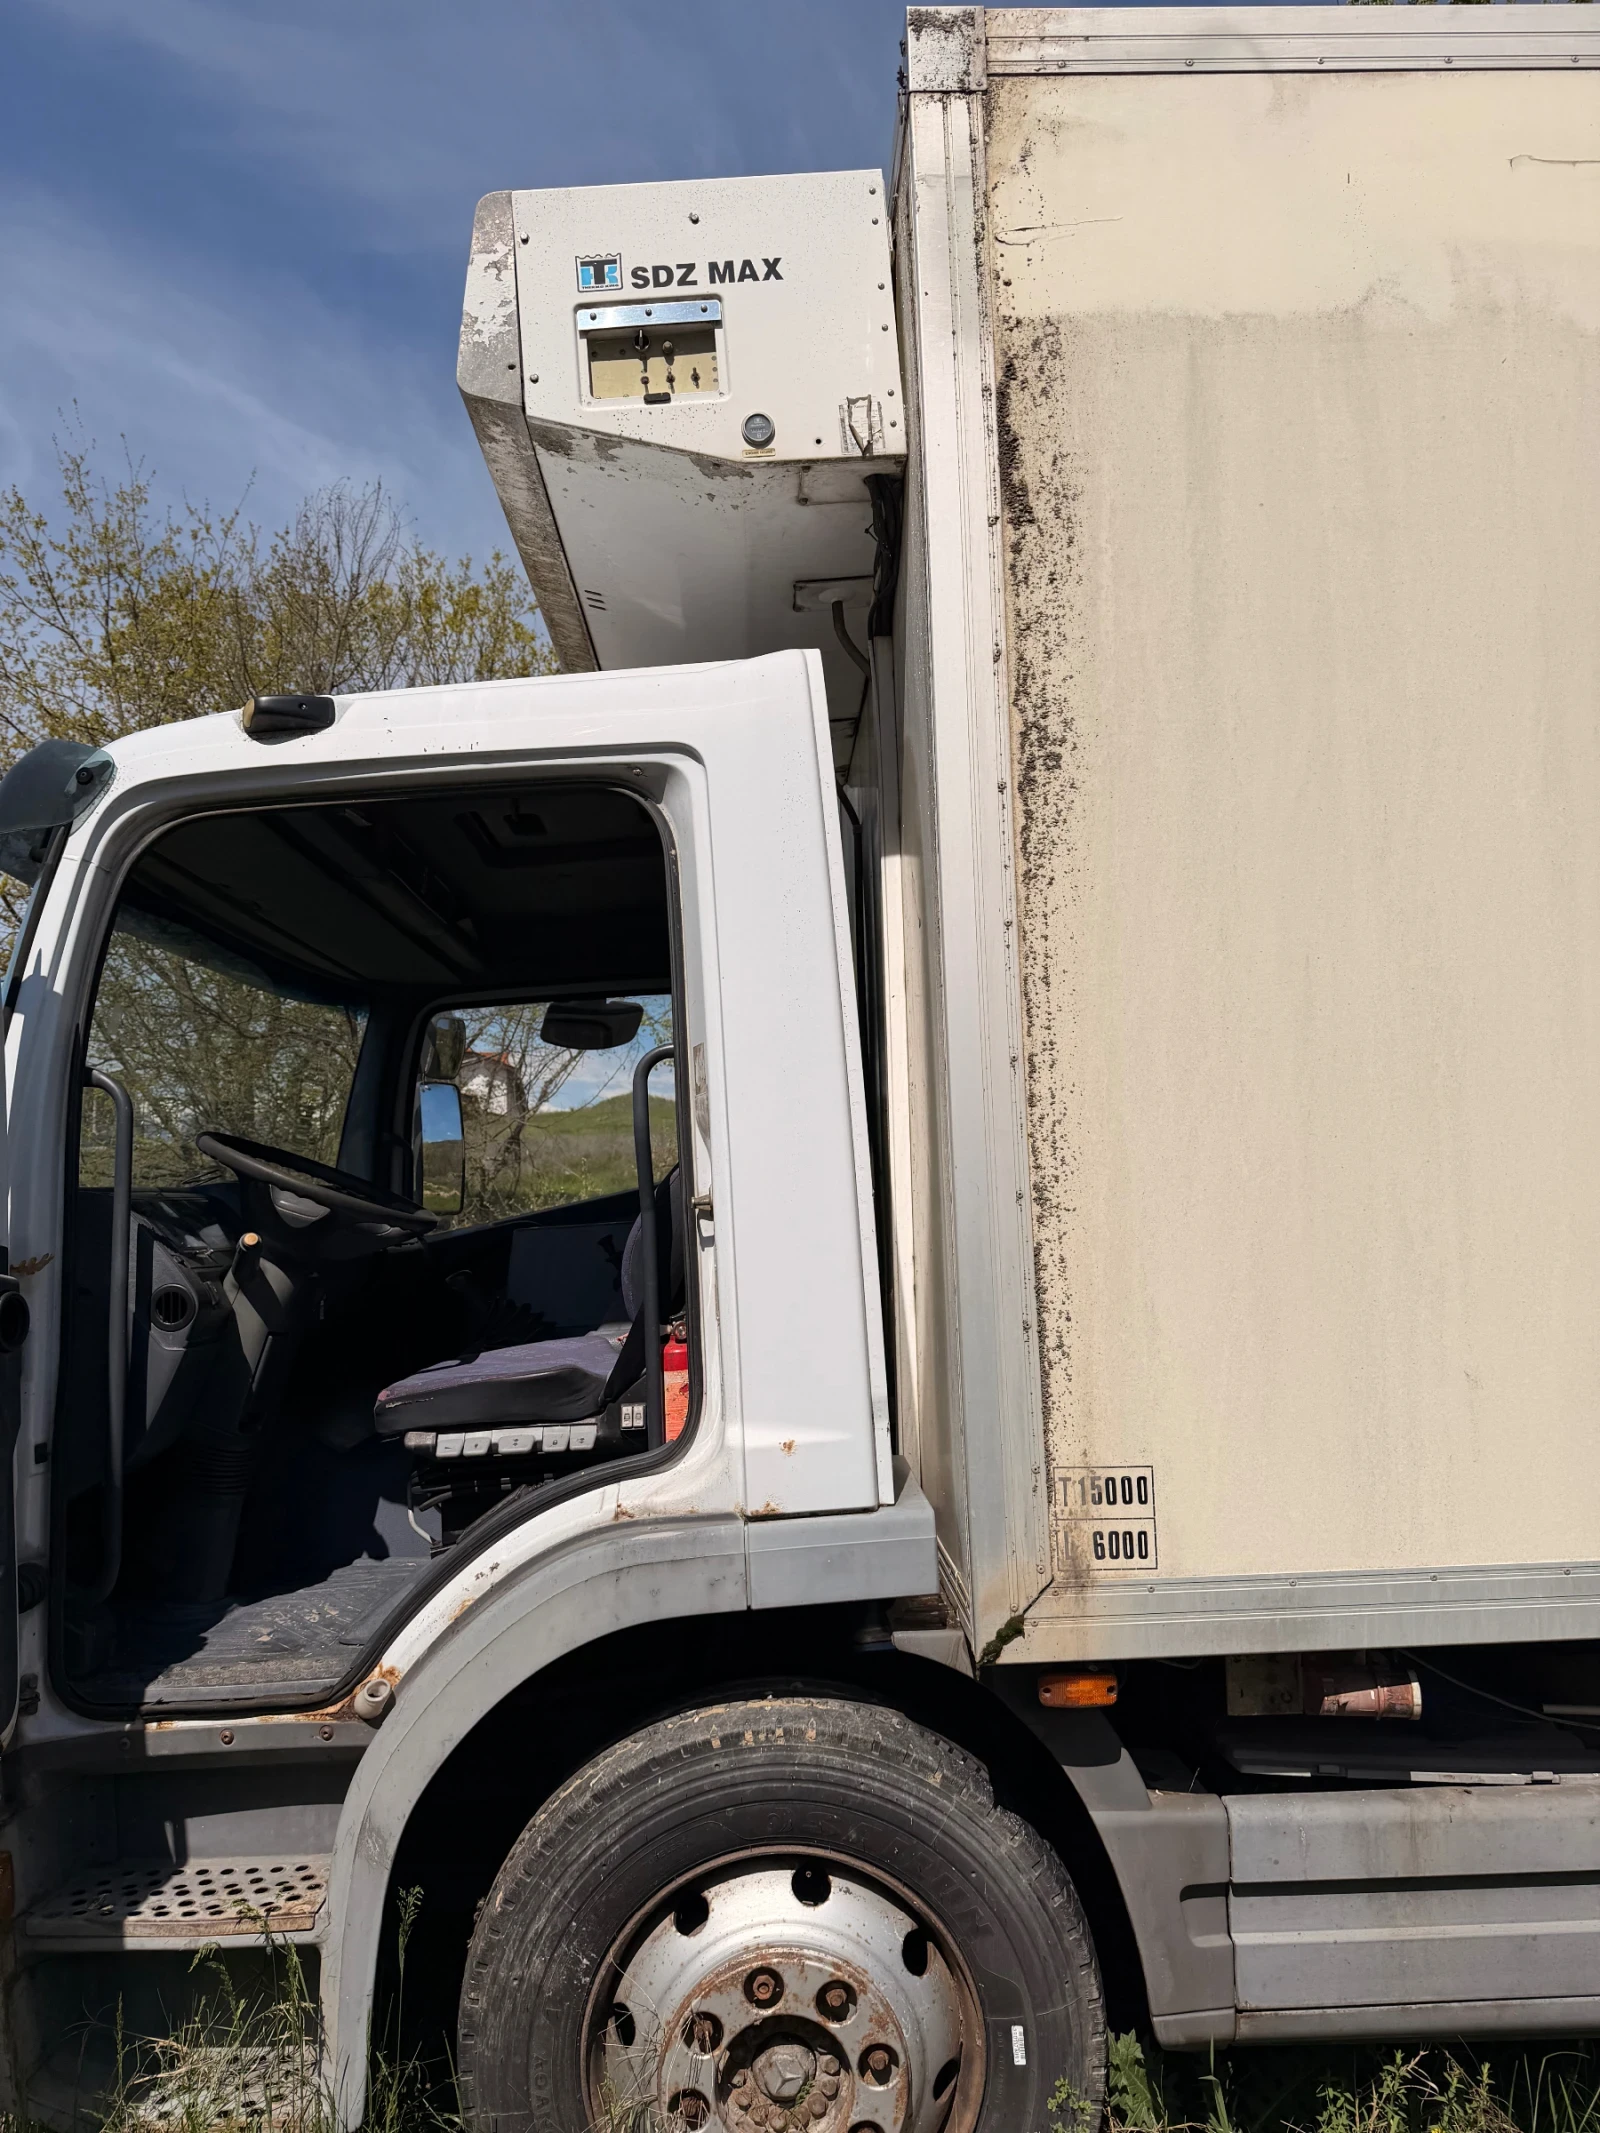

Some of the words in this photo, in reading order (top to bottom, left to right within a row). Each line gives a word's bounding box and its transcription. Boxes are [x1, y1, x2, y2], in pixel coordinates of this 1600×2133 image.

[630, 262, 698, 289] SDZ
[708, 257, 784, 285] MAX
[1092, 1530, 1149, 1561] 6000
